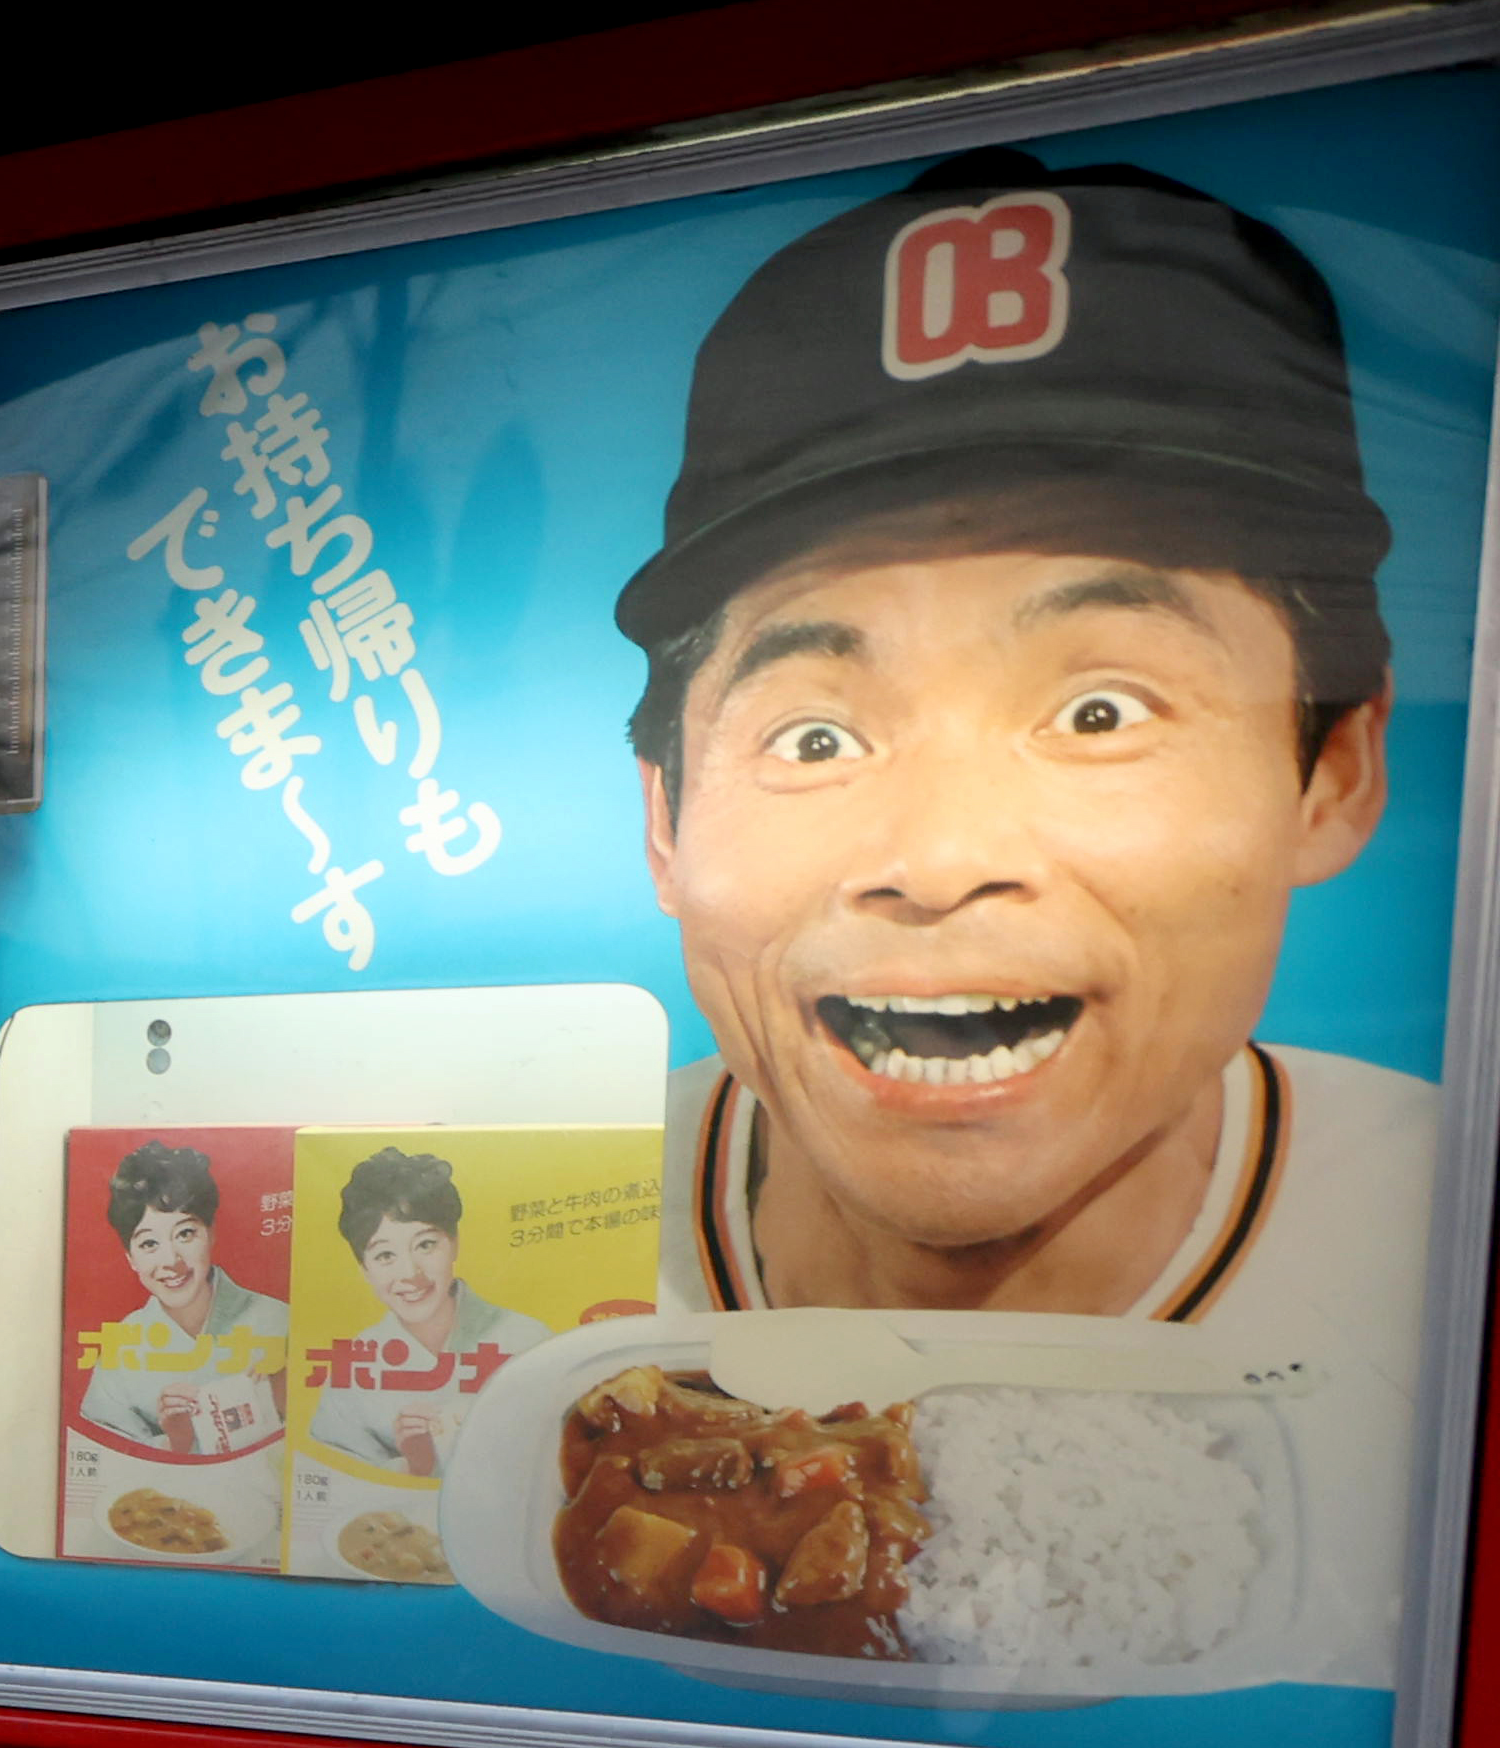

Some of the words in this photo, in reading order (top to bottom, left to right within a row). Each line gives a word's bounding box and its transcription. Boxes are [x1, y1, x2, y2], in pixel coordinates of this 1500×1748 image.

[884, 190, 1070, 381] OB
[189, 312, 502, 877] お持ち帰りも
